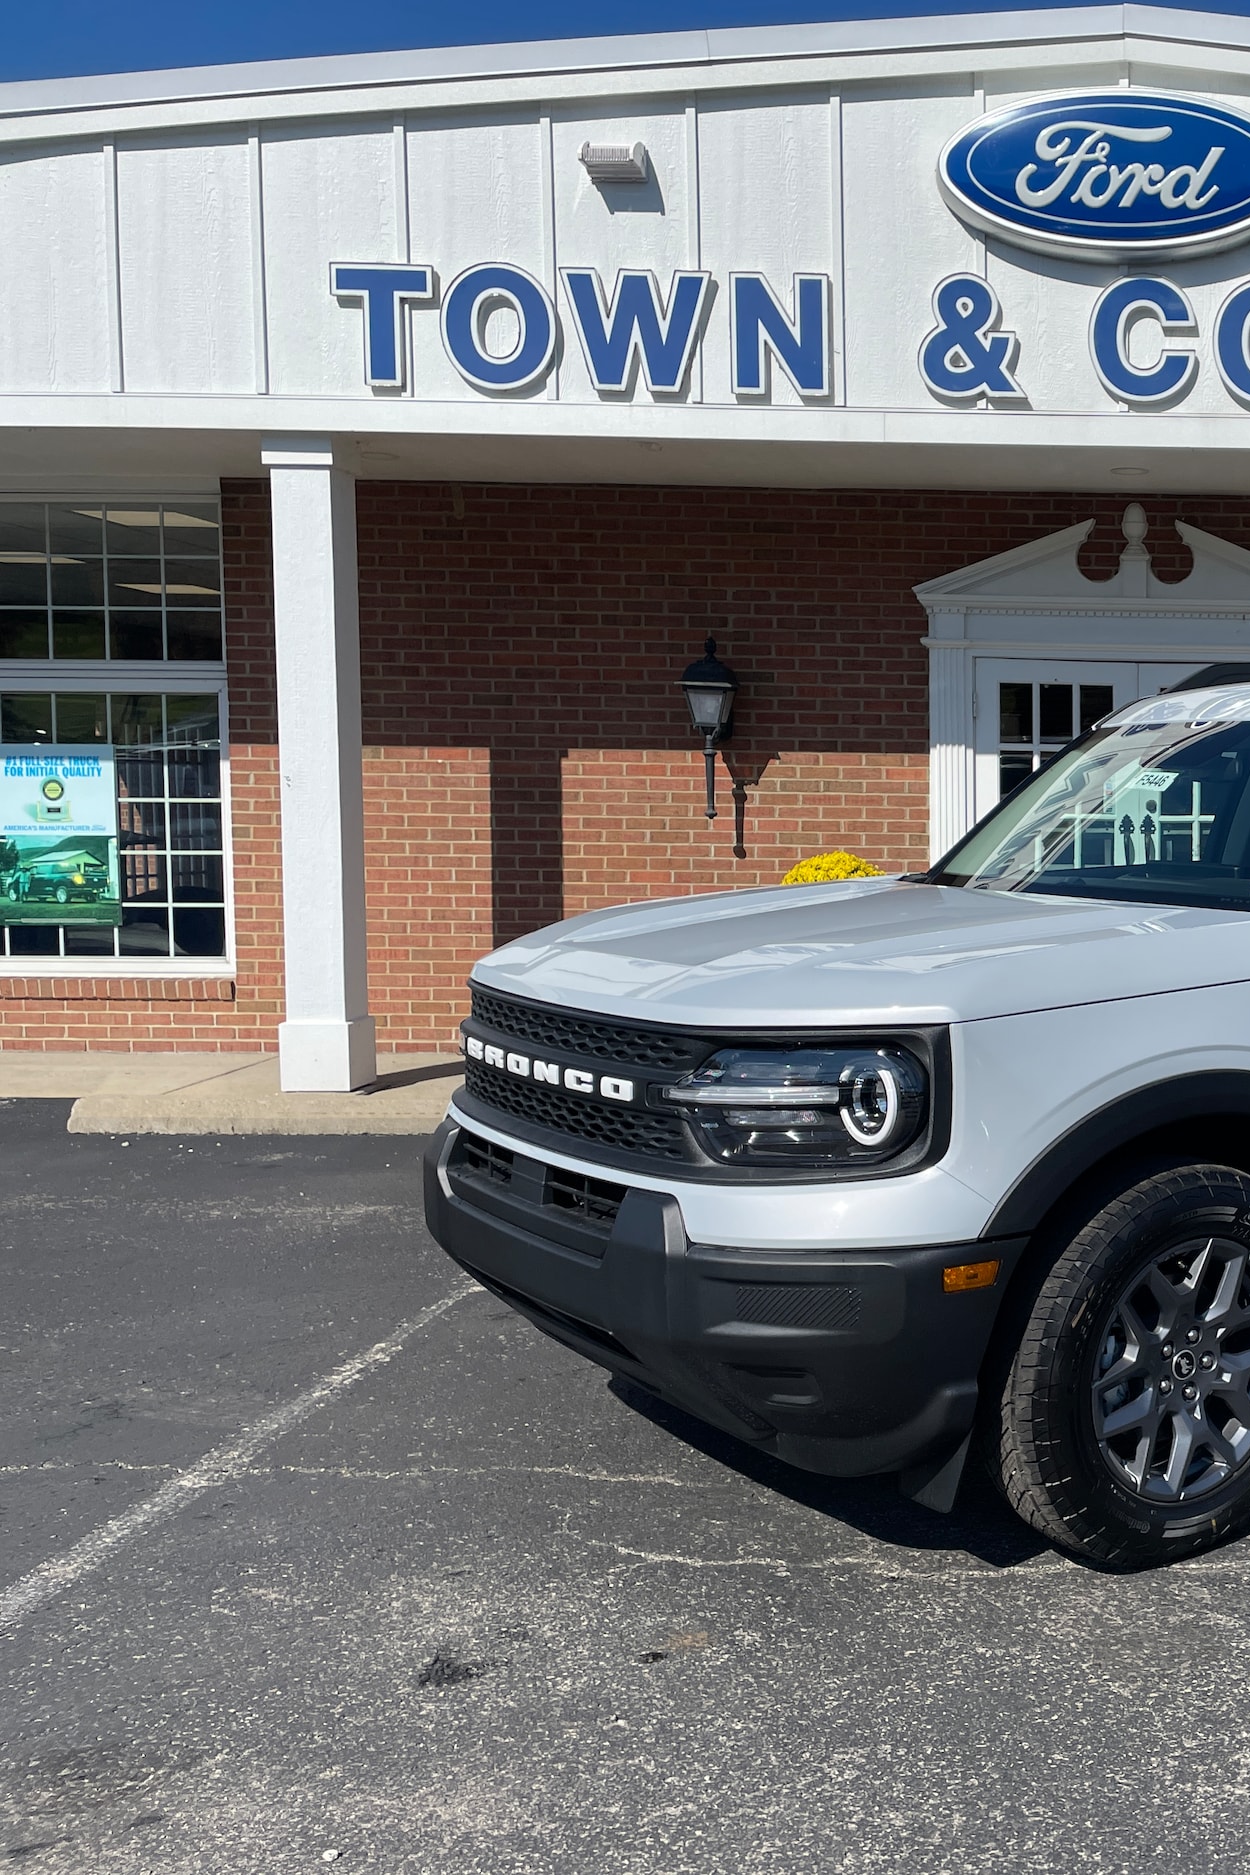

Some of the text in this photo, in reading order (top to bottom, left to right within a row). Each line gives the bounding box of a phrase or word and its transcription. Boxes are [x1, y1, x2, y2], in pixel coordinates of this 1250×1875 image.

[1015, 121, 1225, 210] Ford
[331, 263, 831, 396] TOWN
[917, 272, 1026, 399] &
[5, 767, 102, 778] FOR INITIAL QUALITY
[20, 756, 65, 766] FULL-SIZE
[68, 756, 100, 766] TRUCK
[467, 1036, 634, 1102] BRONCO
